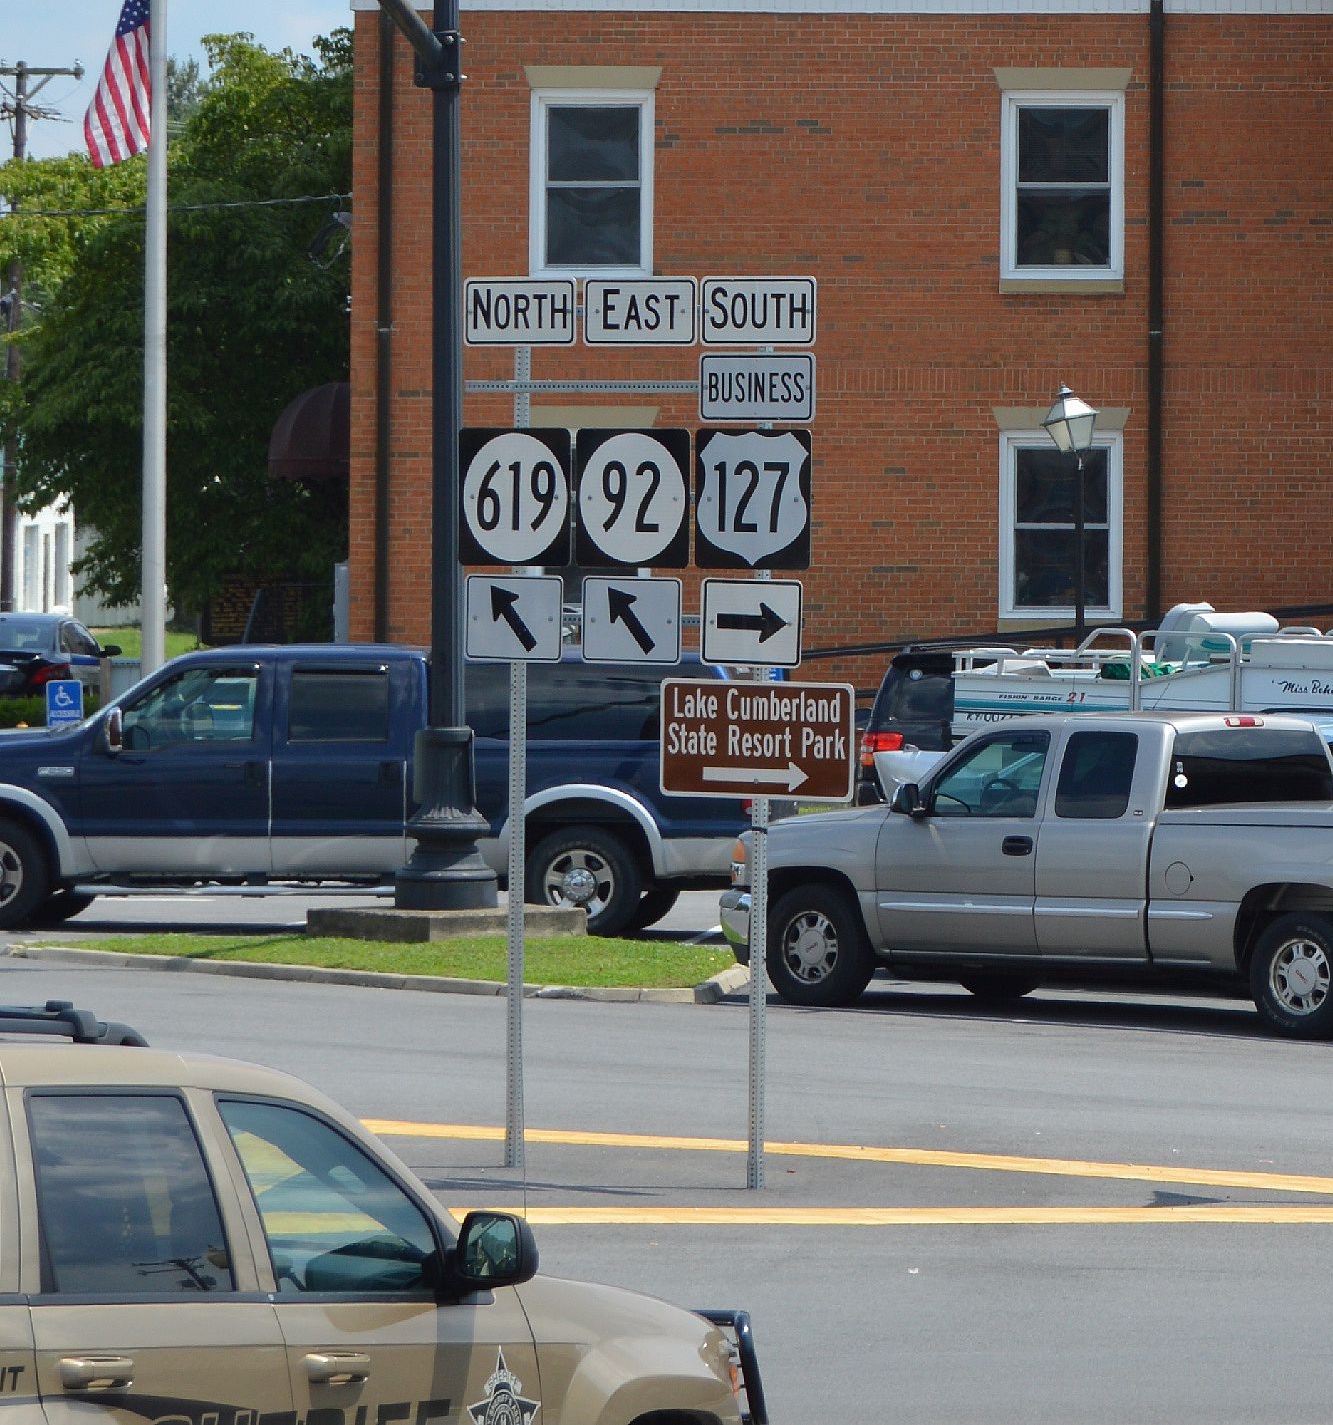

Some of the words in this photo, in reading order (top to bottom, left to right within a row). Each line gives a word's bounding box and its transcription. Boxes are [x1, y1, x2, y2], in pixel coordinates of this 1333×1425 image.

[472, 288, 569, 330] NORTH
[601, 288, 681, 330] EAST
[709, 287, 808, 330] SOUTH
[708, 372, 806, 404] BUSINESS
[476, 460, 557, 532] 619
[601, 460, 660, 533] 92
[713, 461, 791, 534] 127
[673, 686, 718, 720] Lake
[726, 687, 841, 724] Cumberland
[1066, 691, 1086, 703] 21
[667, 722, 717, 756] State
[728, 725, 792, 758] Resort
[802, 727, 847, 760] Park
